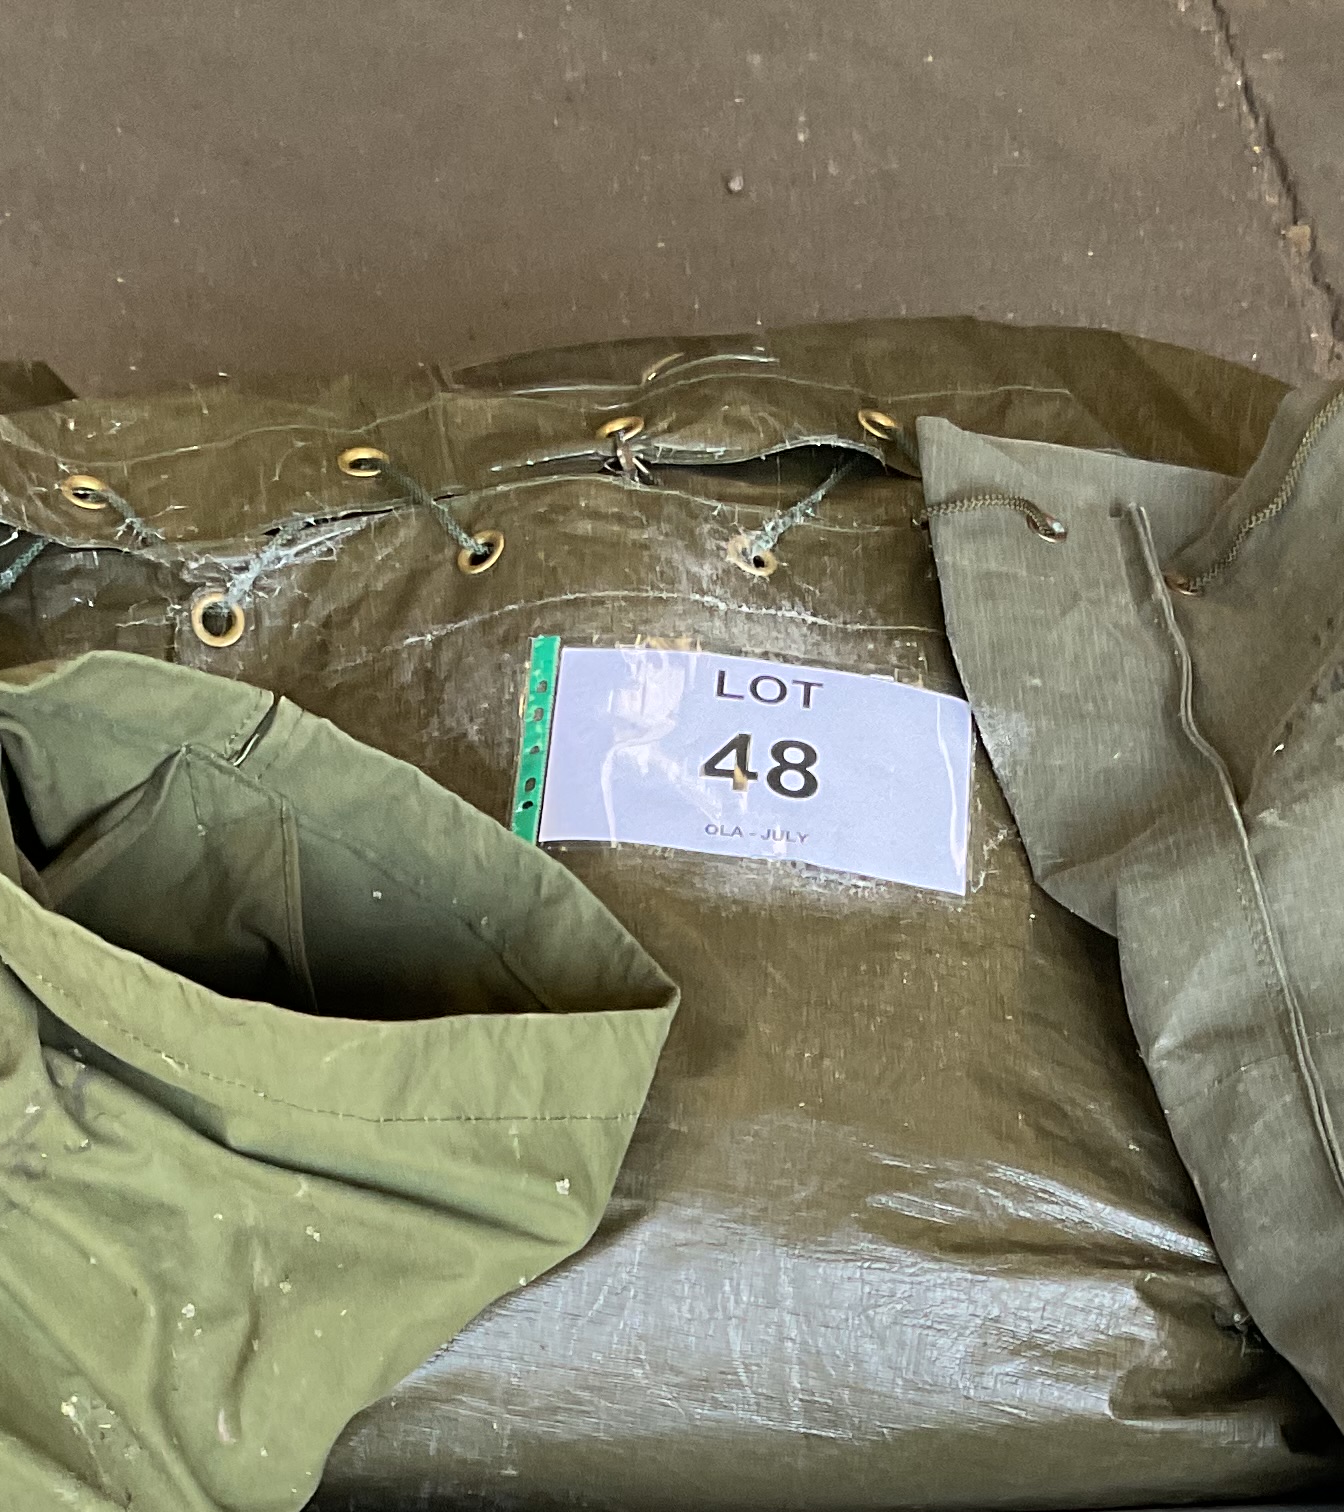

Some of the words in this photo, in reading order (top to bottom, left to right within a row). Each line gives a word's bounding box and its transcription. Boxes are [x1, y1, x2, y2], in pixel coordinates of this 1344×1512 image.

[716, 669, 824, 709] LOT
[699, 732, 819, 799] 48
[704, 823, 744, 838] OLA
[760, 828, 810, 844] JULY
